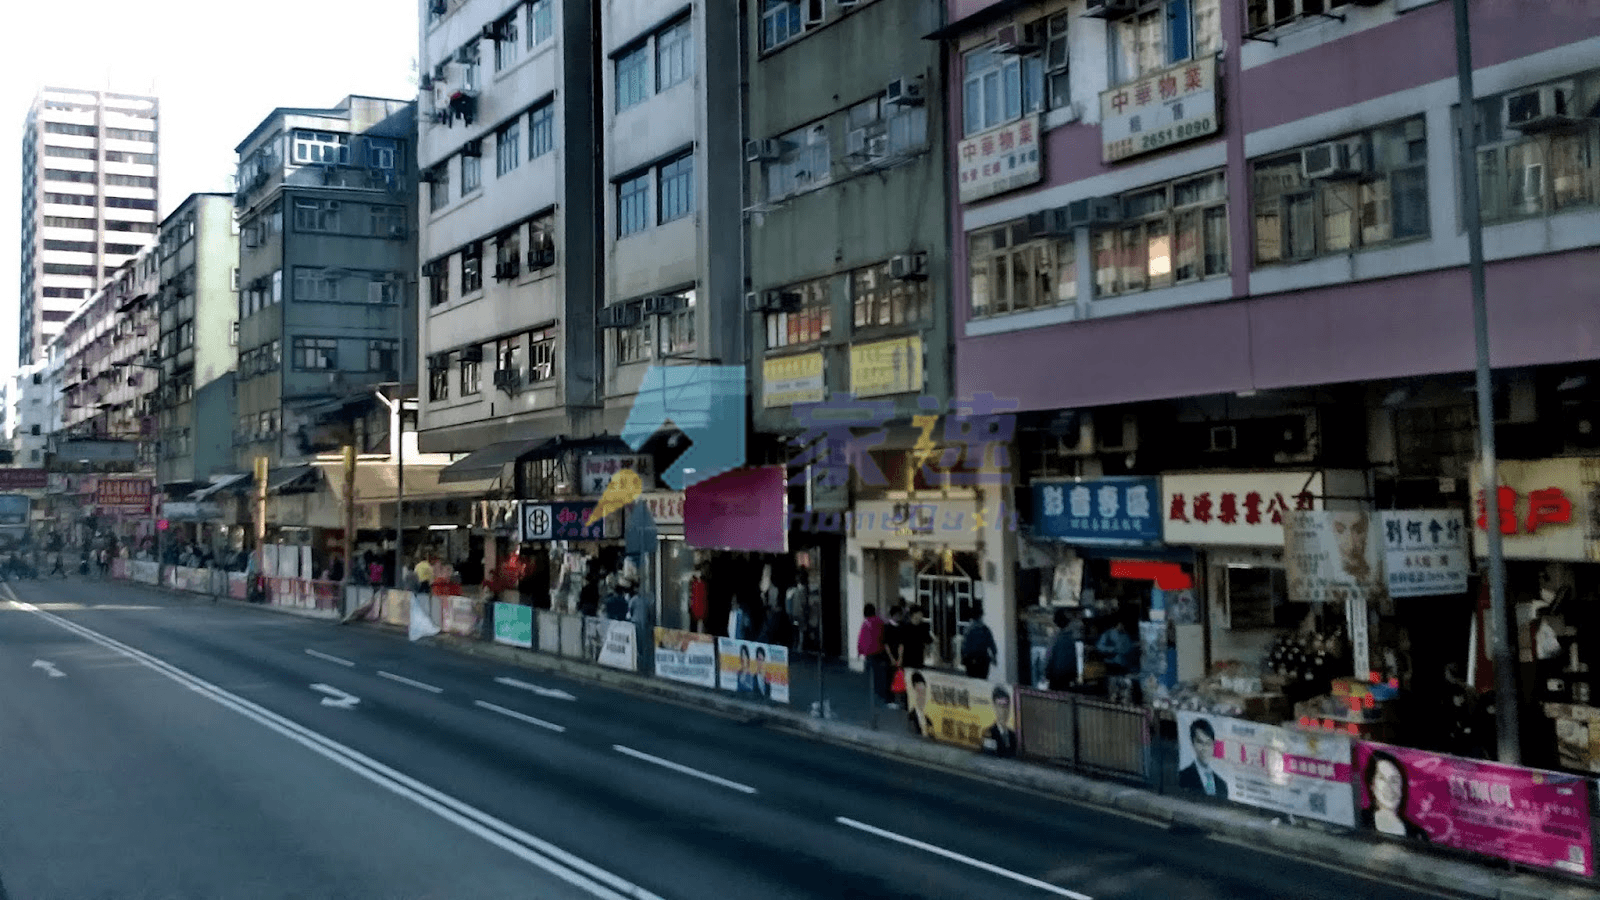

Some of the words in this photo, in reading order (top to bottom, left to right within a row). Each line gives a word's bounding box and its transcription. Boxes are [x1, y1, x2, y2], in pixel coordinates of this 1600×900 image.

[1111, 65, 1202, 115] 中華物業
[963, 121, 1032, 163] 中華物業
